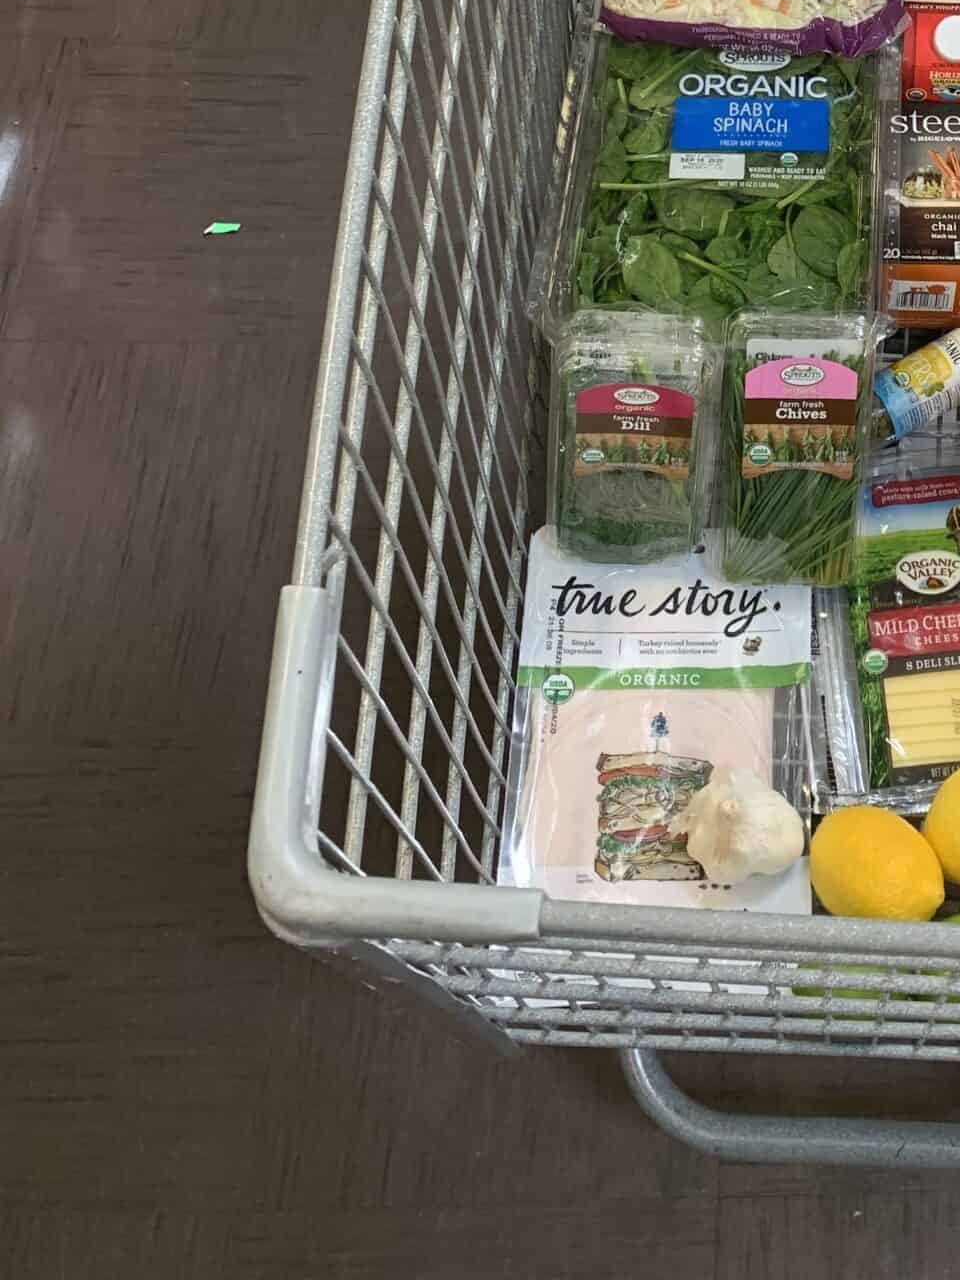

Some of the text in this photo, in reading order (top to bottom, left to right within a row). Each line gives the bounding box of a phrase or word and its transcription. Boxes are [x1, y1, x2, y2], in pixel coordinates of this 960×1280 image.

[678, 73, 828, 99] ORGANIC
[728, 101, 774, 117] BABY
[713, 117, 788, 134] SPINACH
[931, 221, 957, 232] chai
[883, 247, 900, 259] 20
[775, 407, 828, 420] Chives
[620, 419, 651, 432] Dill
[898, 557, 960, 574] ORGANIC
[907, 567, 955, 581] VALLEY
[551, 575, 645, 618] true
[873, 616, 920, 638] MILD
[571, 639, 596, 648] Simple
[638, 639, 663, 649] Turkey
[685, 639, 719, 648] humanely
[905, 660, 913, 671] 8
[915, 658, 942, 670] DELI
[619, 673, 700, 686] ORGANIC
